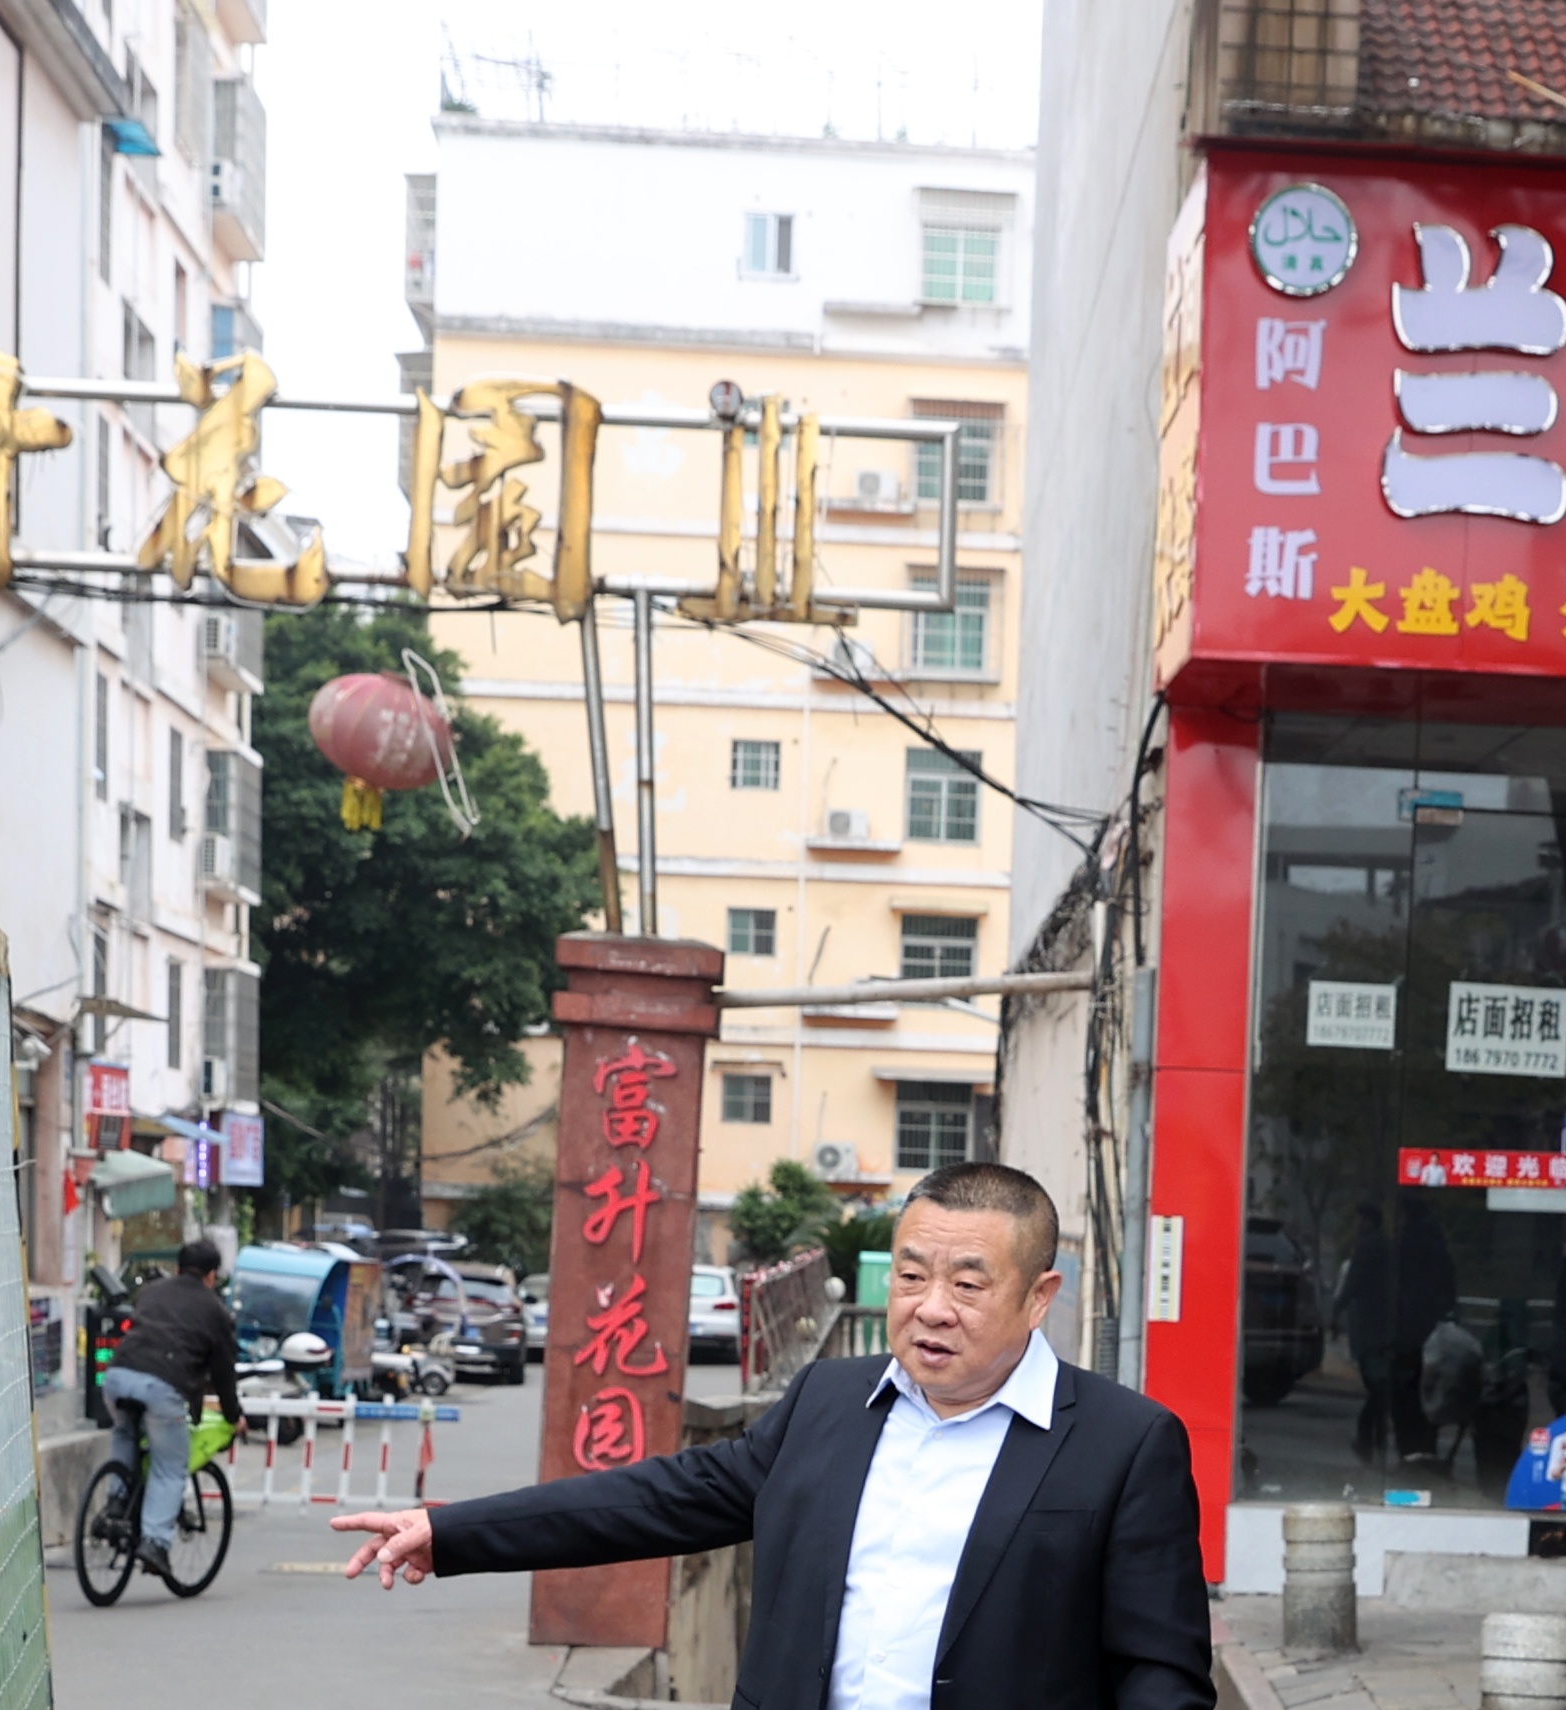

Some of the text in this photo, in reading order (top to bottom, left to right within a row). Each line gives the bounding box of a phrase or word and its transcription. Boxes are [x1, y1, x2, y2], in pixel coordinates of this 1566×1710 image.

[1243, 314, 1328, 602] 阿巴斯
[1328, 564, 1532, 640] 大盘鸡
[1316, 991, 1392, 1020] 店面招租
[1453, 992, 1562, 1043] 店面招租
